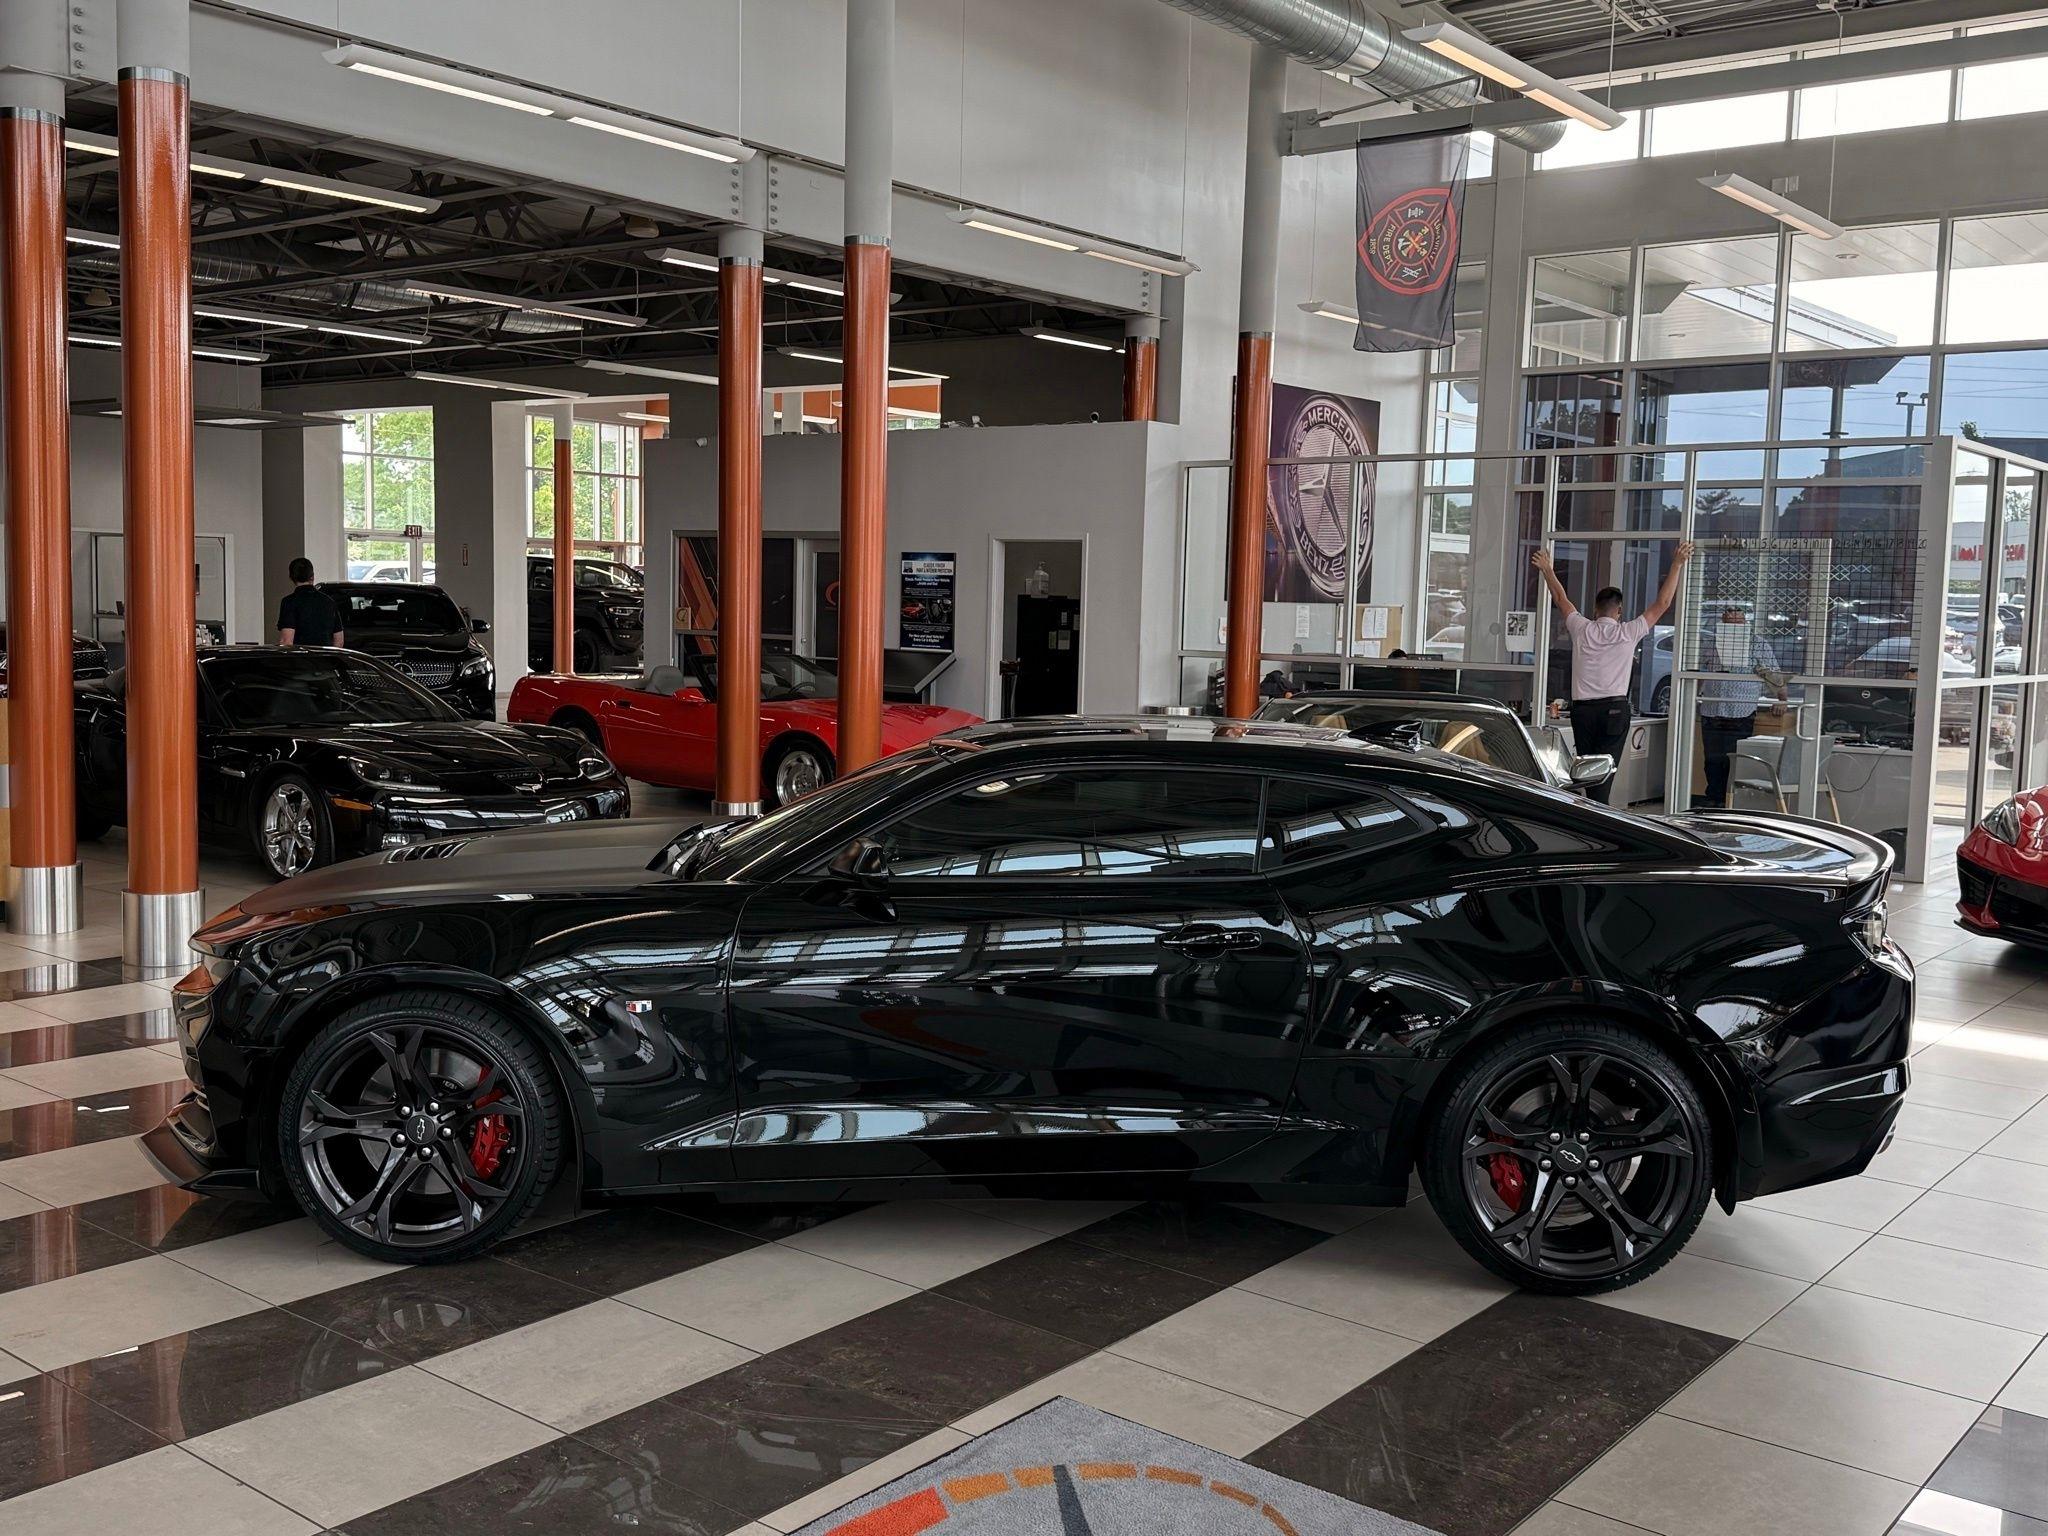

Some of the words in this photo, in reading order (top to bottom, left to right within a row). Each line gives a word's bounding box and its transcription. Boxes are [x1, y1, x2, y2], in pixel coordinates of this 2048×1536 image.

[1383, 223, 1396, 243] FIRE
[1307, 406, 1362, 456] MERCEDE
[408, 526, 421, 536] EXIT
[1300, 535, 1331, 578] BENZ
